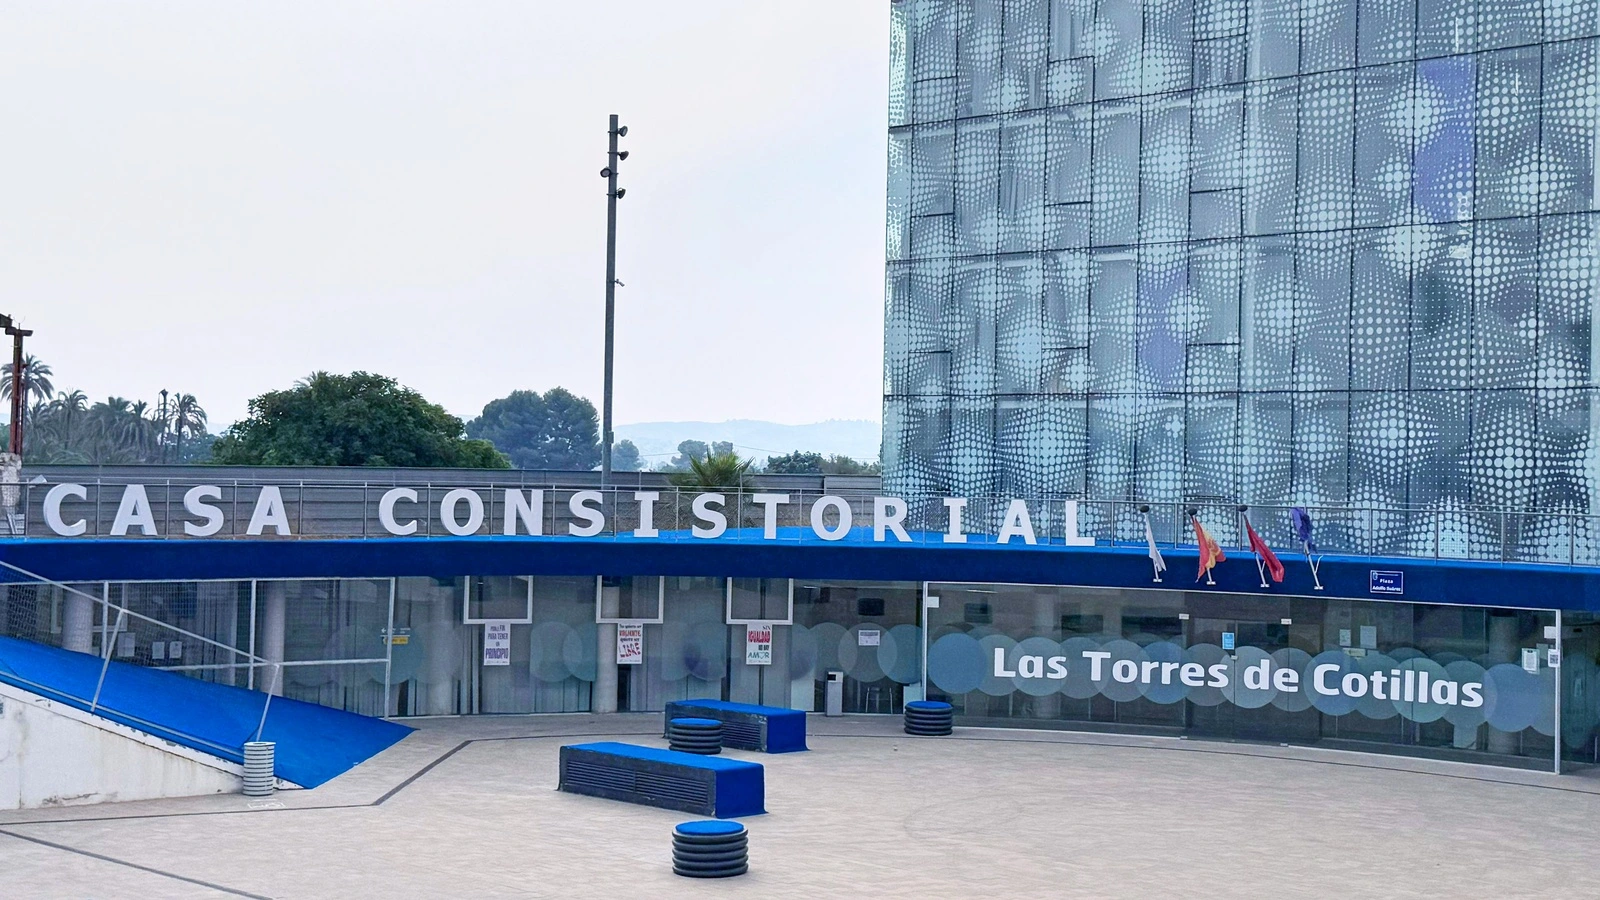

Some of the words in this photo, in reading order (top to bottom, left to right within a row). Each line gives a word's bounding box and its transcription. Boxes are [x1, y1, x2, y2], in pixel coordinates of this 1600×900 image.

[43, 483, 292, 537] CASA
[378, 487, 1096, 547] CONSISTORIAL
[748, 630, 770, 643] IGUALDAD
[993, 647, 1068, 680] Las
[1082, 650, 1229, 689] Torres
[1243, 658, 1299, 693] de
[1313, 663, 1484, 708] Cotillas
